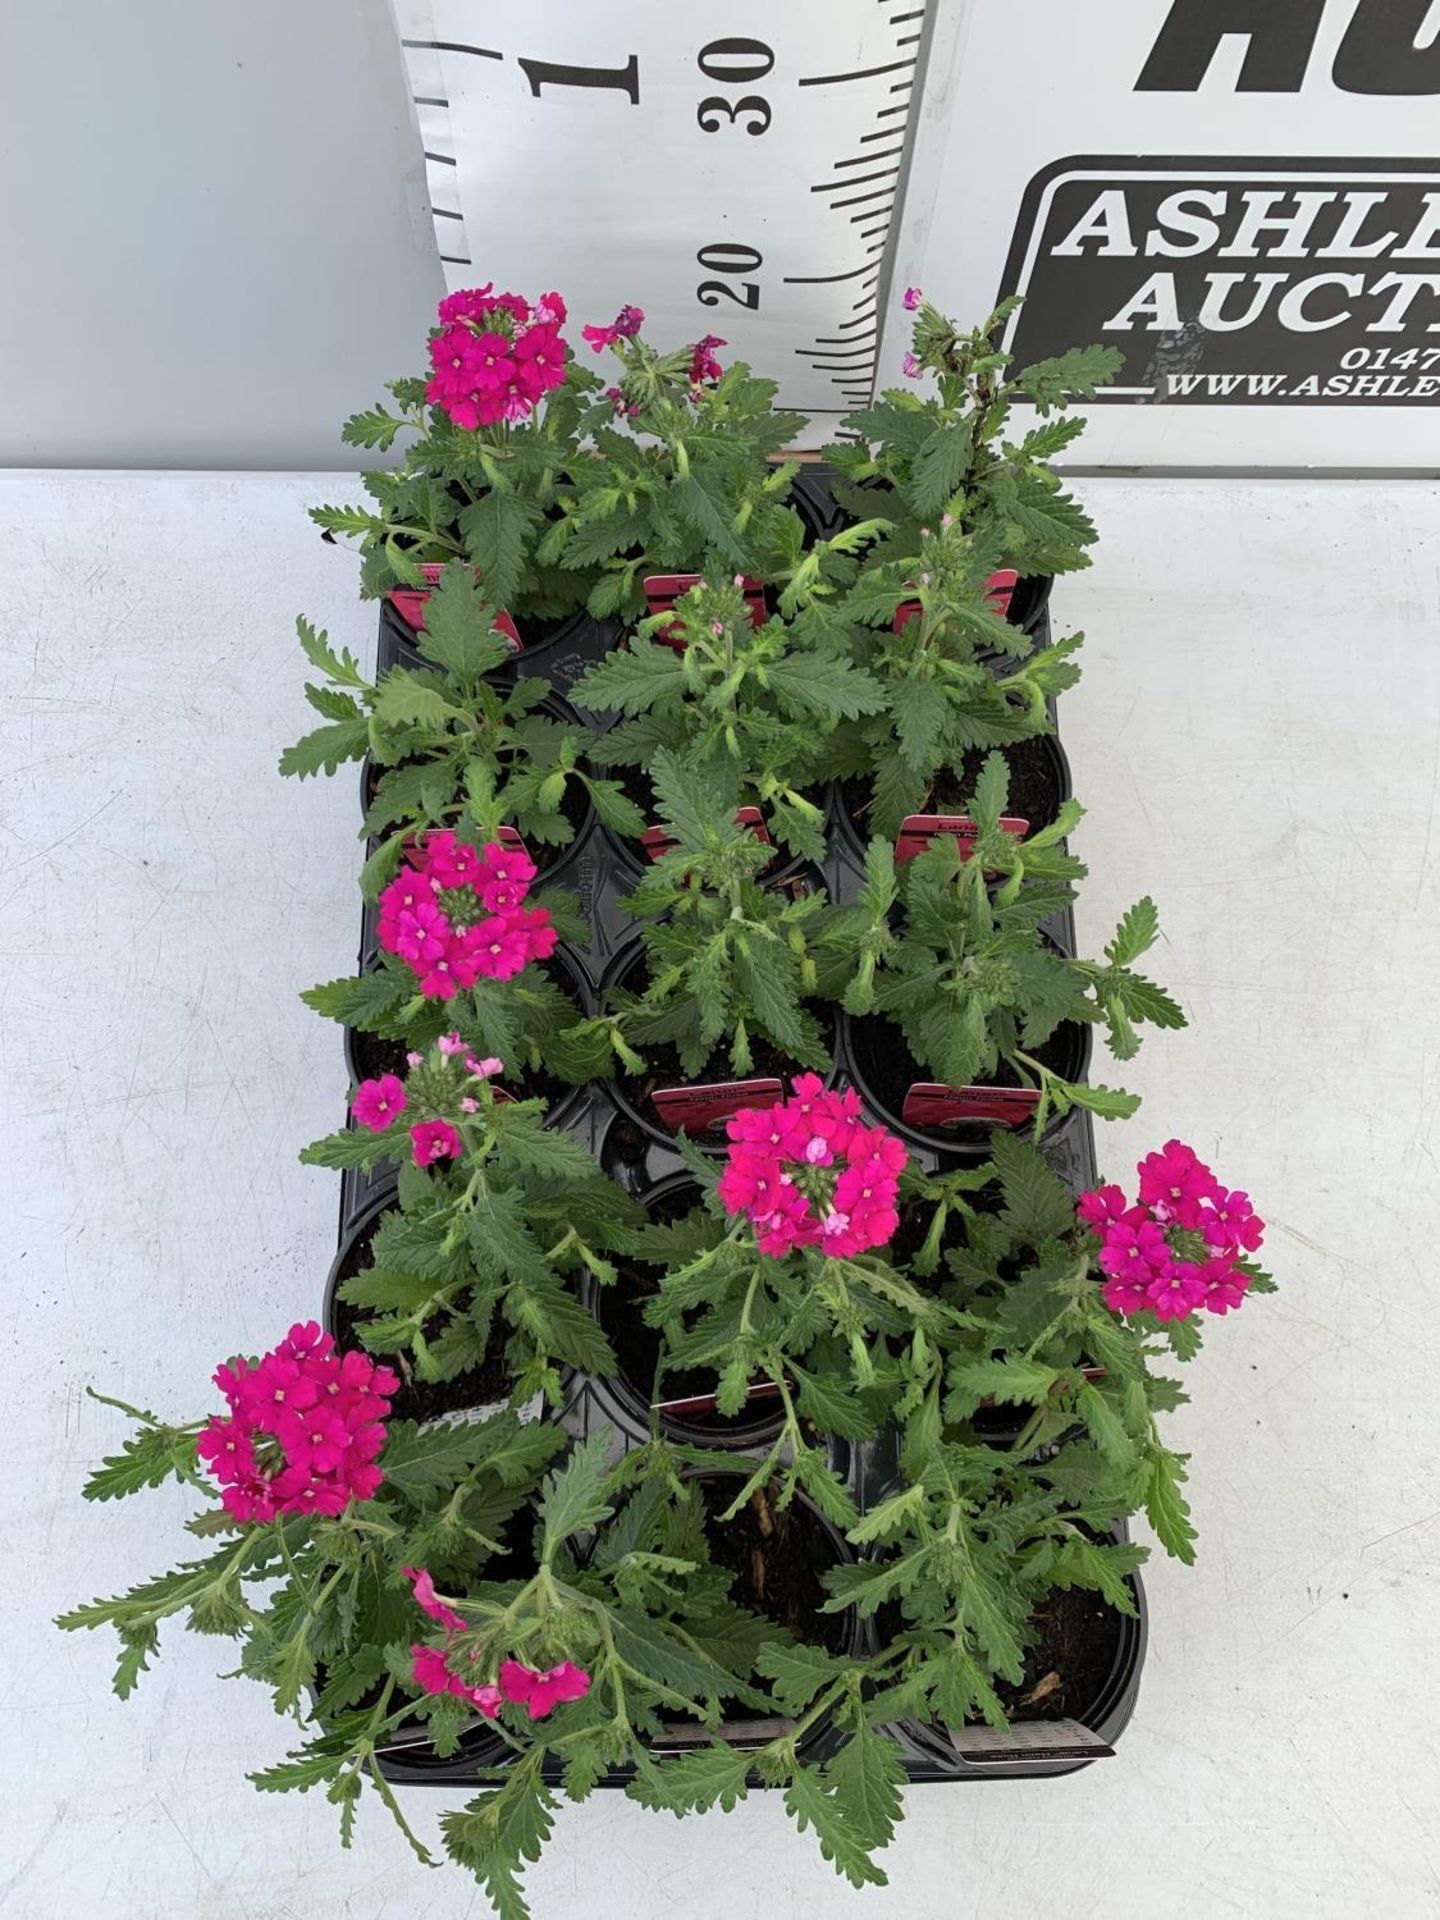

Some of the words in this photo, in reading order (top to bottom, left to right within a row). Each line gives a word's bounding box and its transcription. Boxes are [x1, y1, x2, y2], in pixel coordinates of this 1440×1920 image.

[517, 54, 640, 105] 1
[697, 37, 775, 136] 30
[696, 243, 763, 311] 20
[1101, 271, 1440, 333] AUCT
[1166, 374, 1440, 397] WWW.ASHLE
